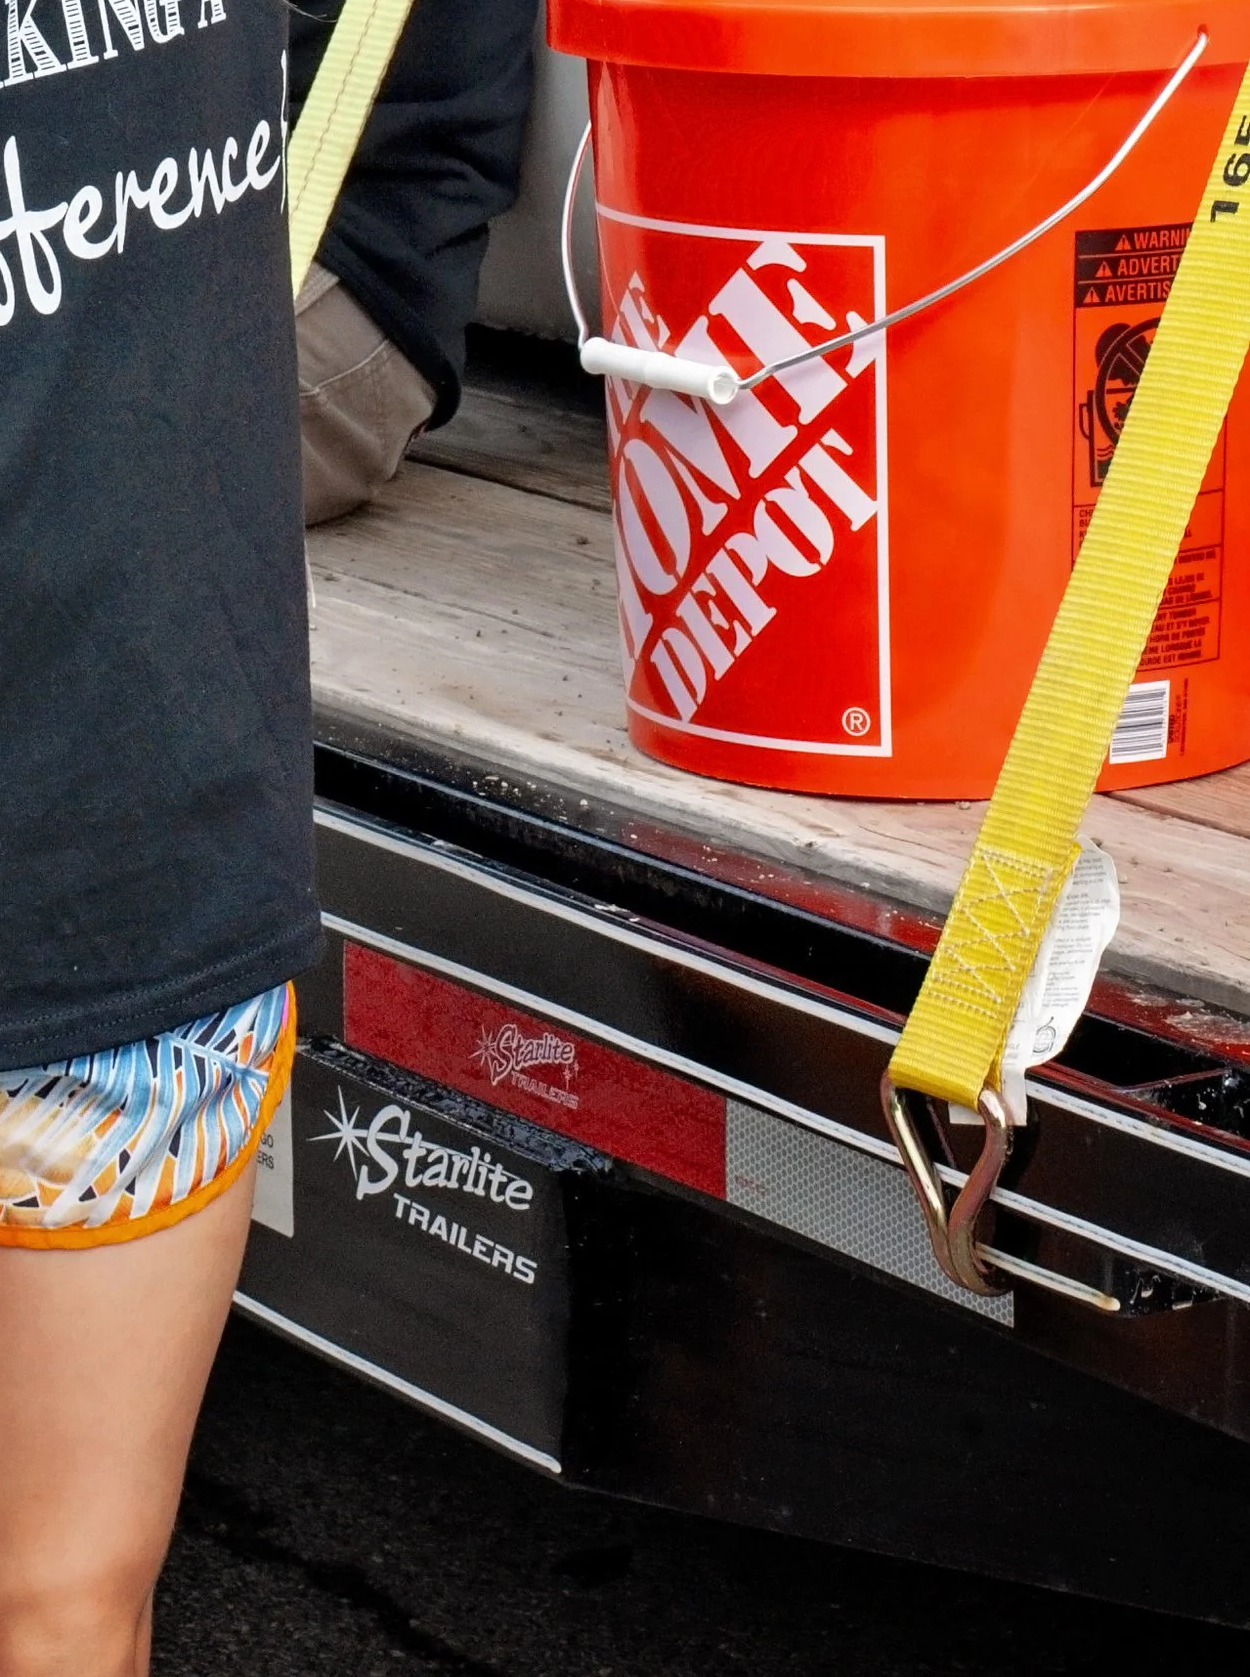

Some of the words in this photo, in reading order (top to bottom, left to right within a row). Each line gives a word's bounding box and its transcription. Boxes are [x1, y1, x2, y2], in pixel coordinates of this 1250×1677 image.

[1117, 255, 1181, 277] ADVERT
[1134, 227, 1192, 250] WARNI
[650, 428, 878, 723] DEPOT
[490, 1023, 575, 1086] Starlite
[356, 1103, 534, 1210] Starlite
[393, 1192, 538, 1284] TRAILERS
